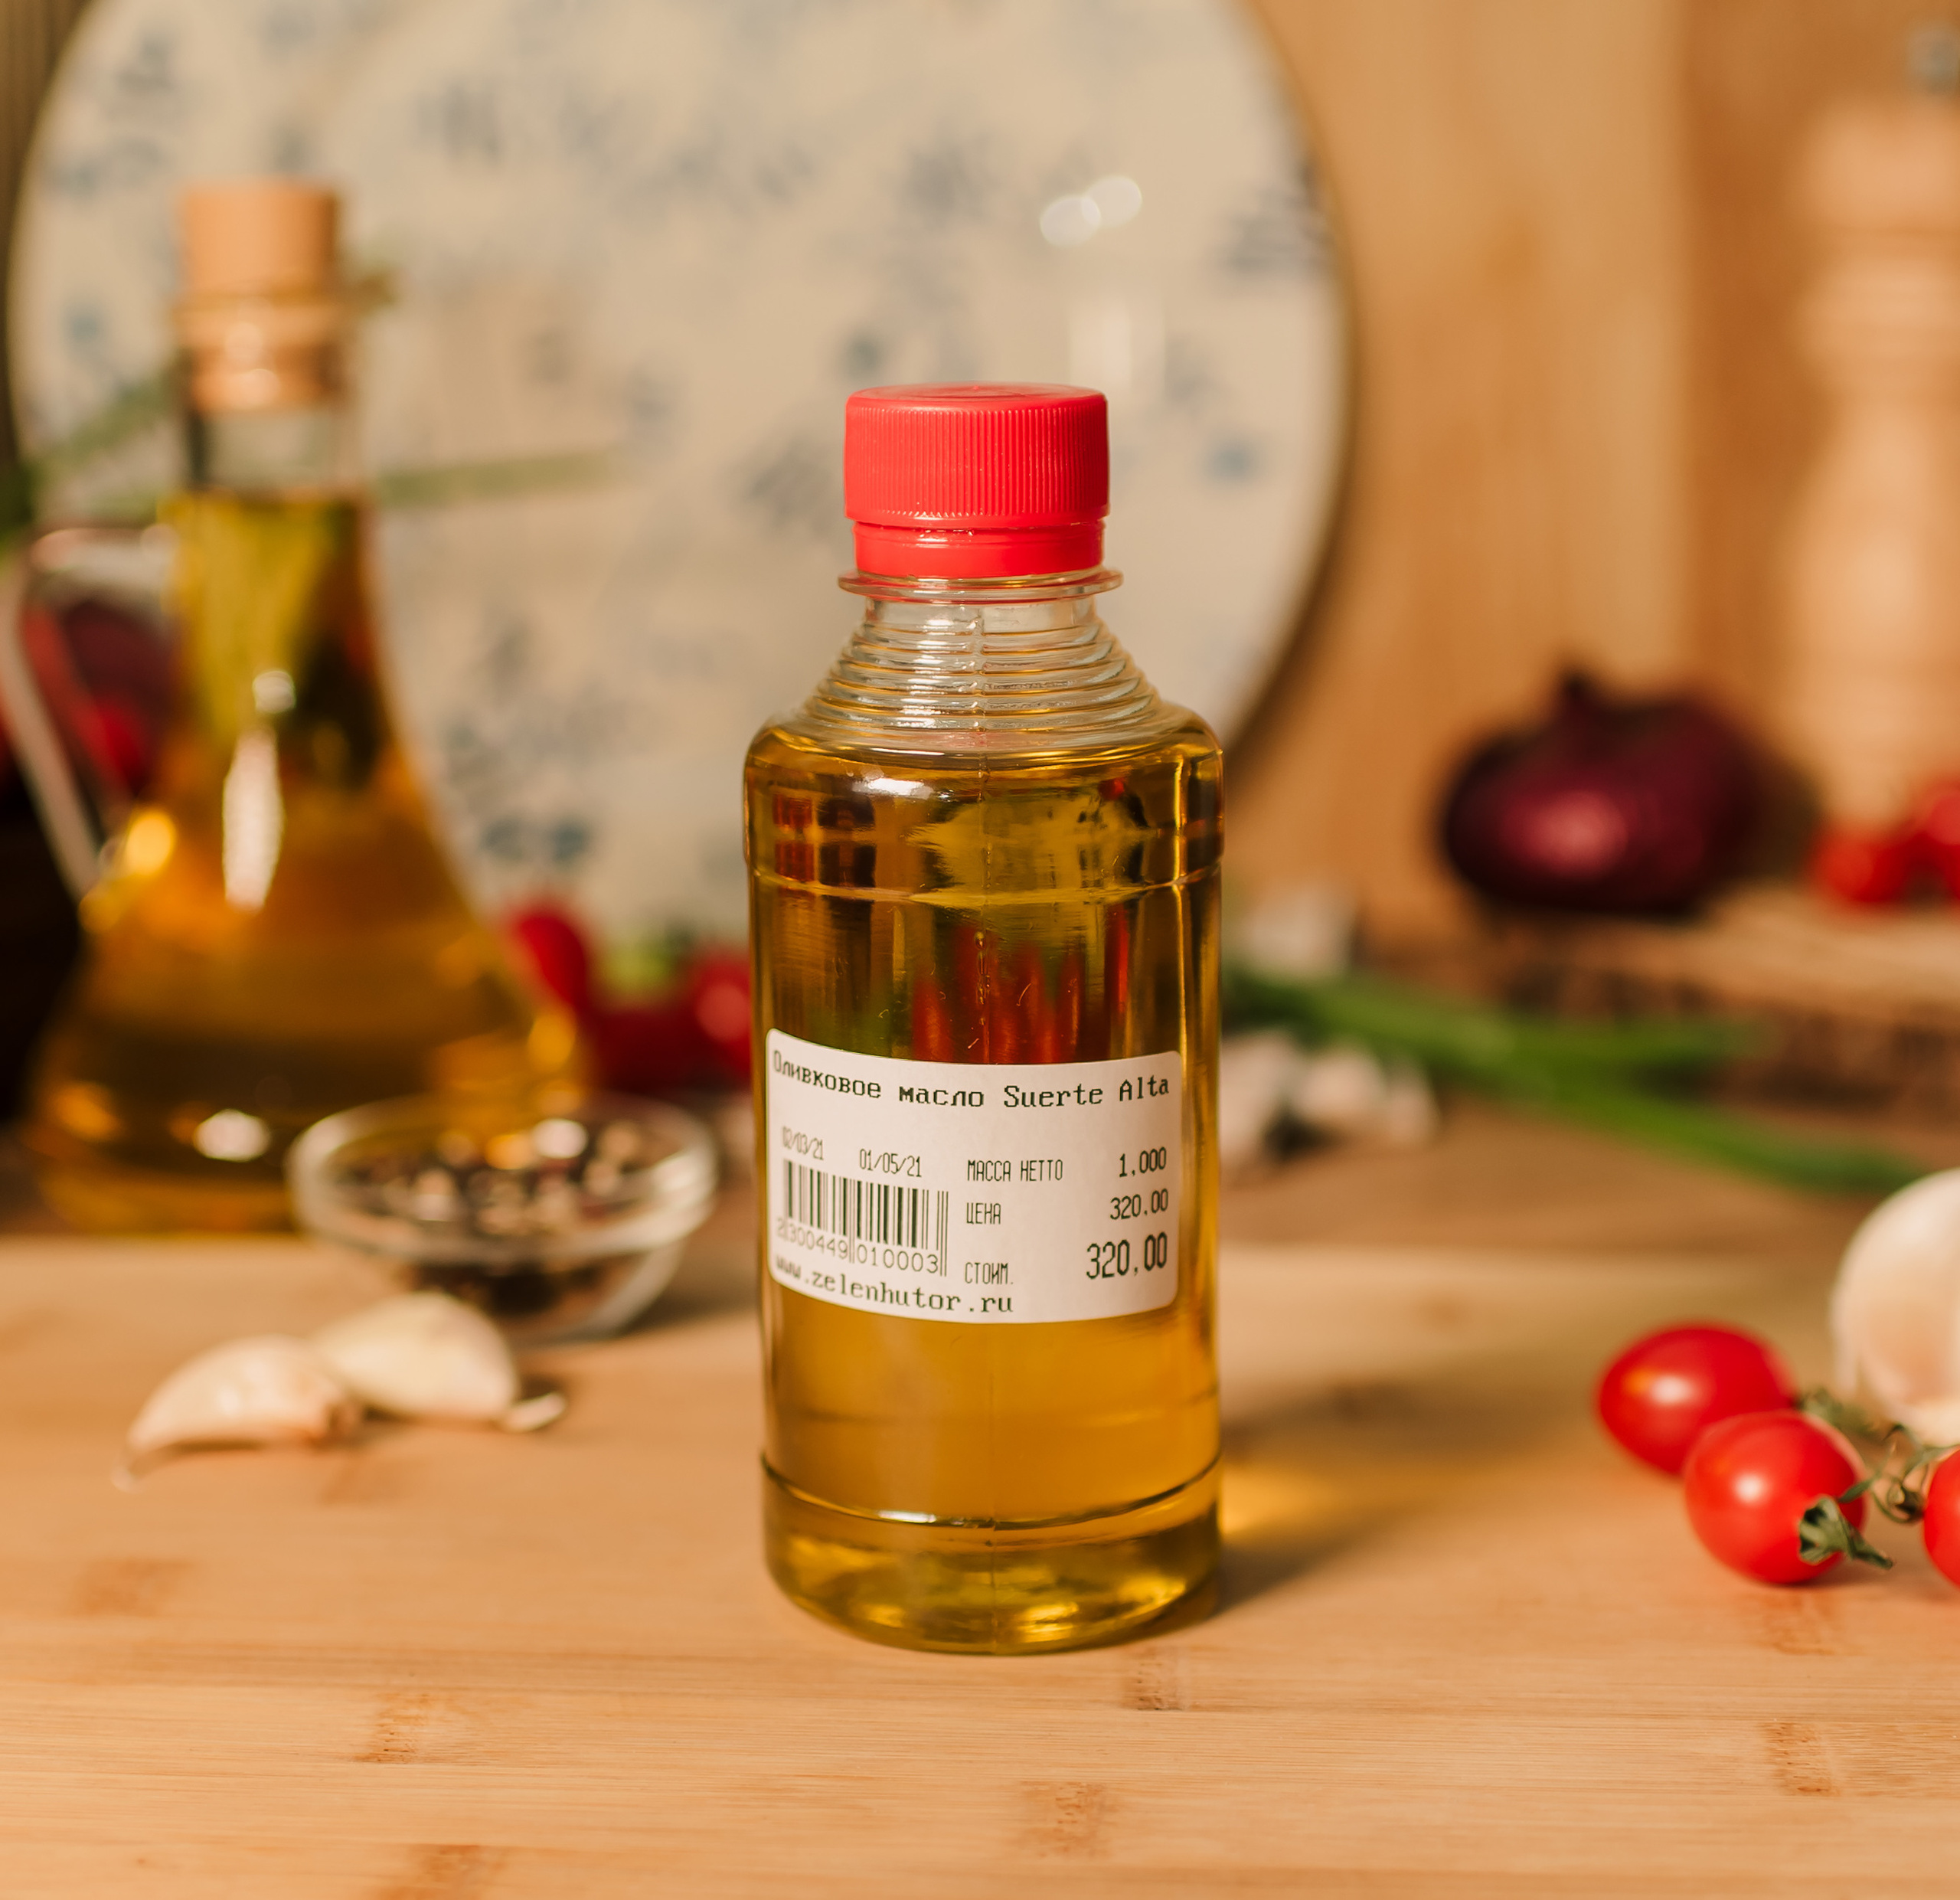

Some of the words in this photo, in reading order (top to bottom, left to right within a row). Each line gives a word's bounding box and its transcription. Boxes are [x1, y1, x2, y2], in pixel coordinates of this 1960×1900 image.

[773, 1050, 881, 1099] Оливковое
[899, 1086, 984, 1107] масло
[1004, 1084, 1103, 1107] Suerte
[1119, 1074, 1169, 1101] Alta
[859, 1148, 922, 1177] 01/05/21
[967, 1159, 1011, 1182] МАССА
[1021, 1159, 1063, 1182] НЕТТО
[966, 1202, 1001, 1225] ЦЕНА
[776, 1254, 1014, 1313] www.zelenhutor.ru
[965, 1262, 1014, 1285] СТОИМ.
